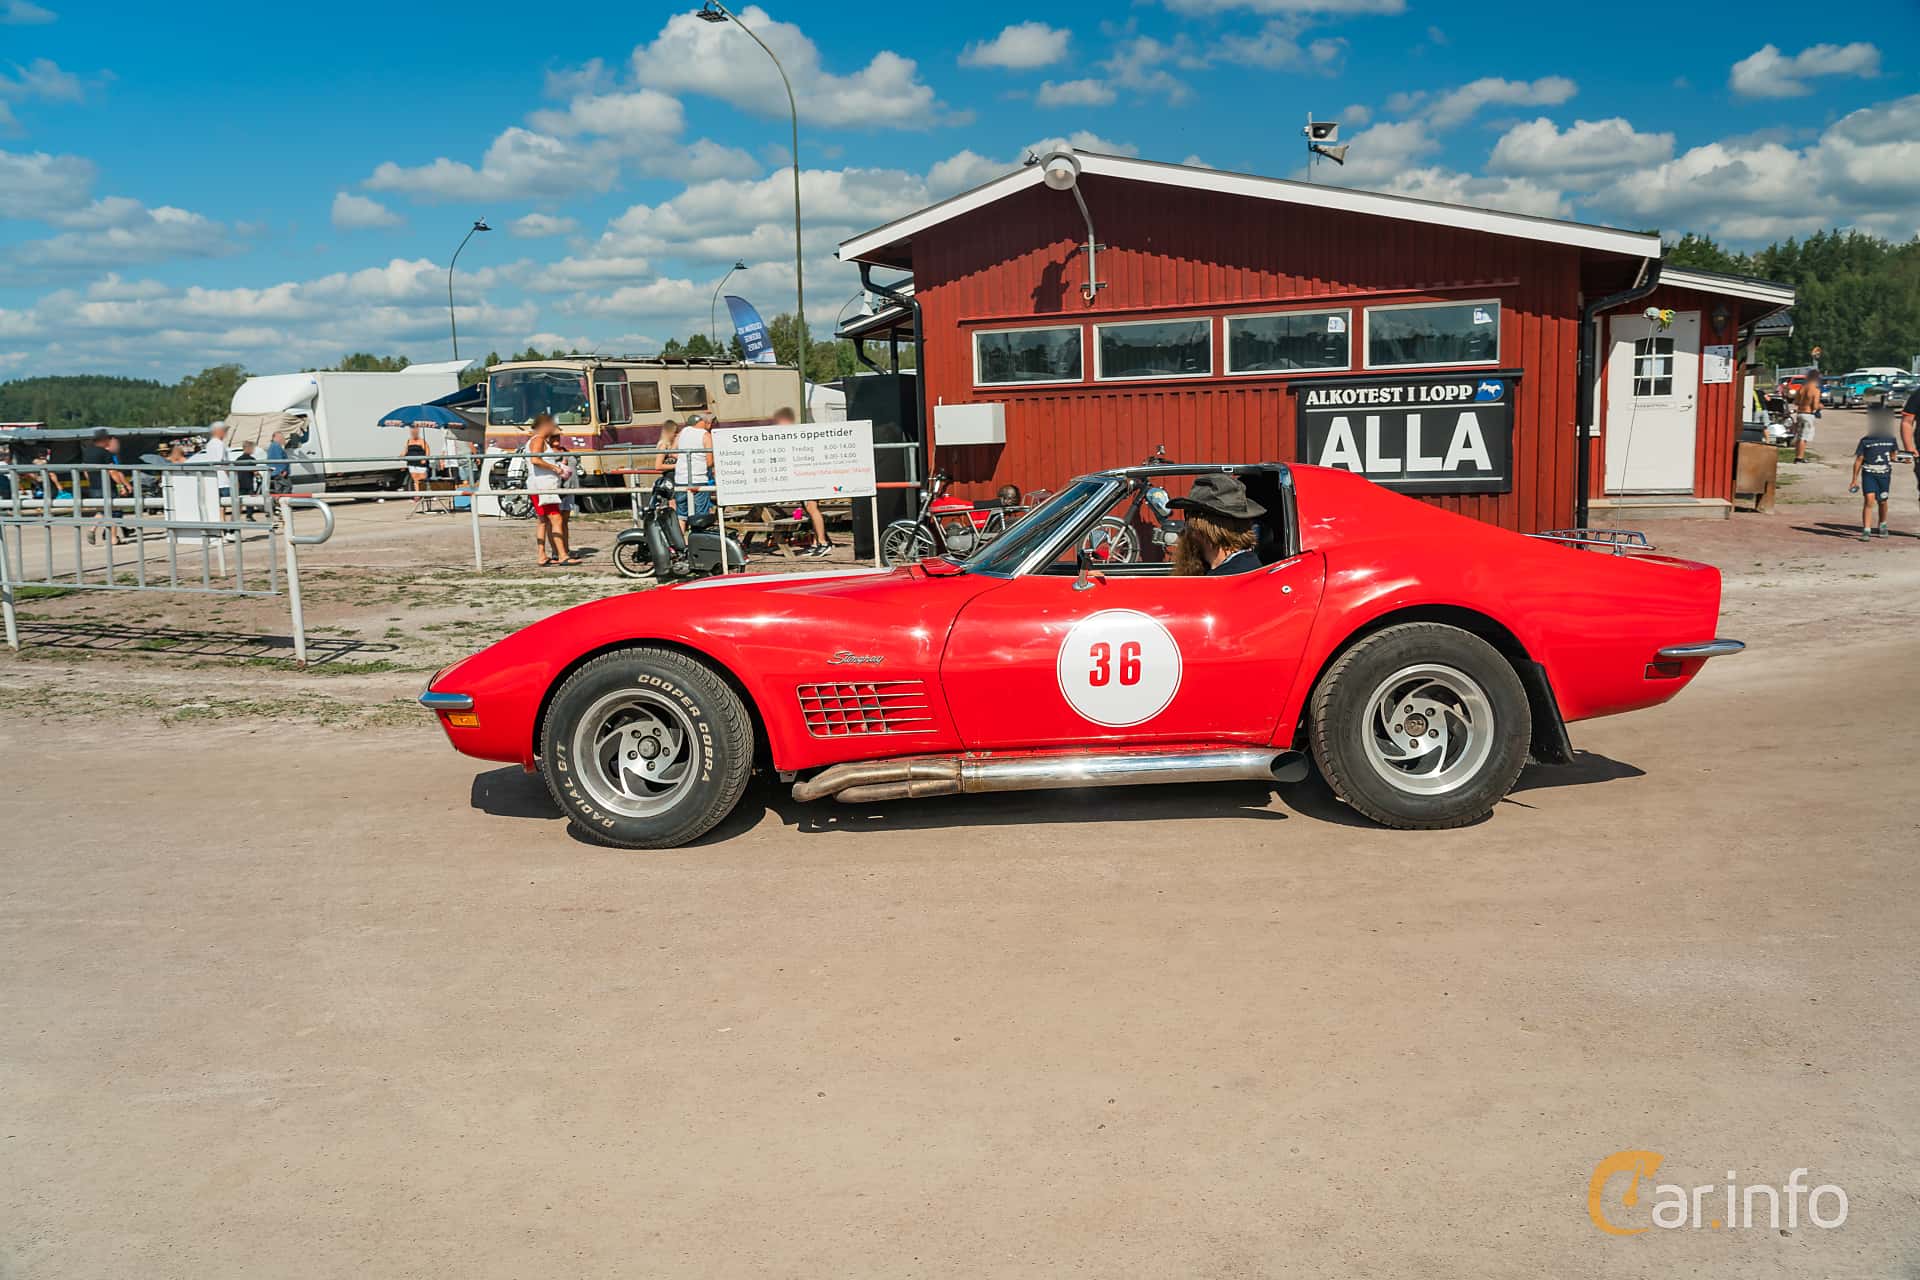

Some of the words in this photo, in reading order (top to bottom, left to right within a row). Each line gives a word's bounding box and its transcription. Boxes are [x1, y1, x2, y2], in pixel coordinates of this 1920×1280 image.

[1306, 386, 1403, 406] ALKOTEST
[1408, 387, 1415, 401] I
[1420, 384, 1473, 401] LOPP
[732, 434, 759, 443] Stora
[761, 432, 798, 441] banans
[1318, 411, 1493, 473] ALLA
[1089, 641, 1141, 687] 36
[638, 674, 701, 717] COOPER
[699, 722, 713, 783] COBRA
[564, 777, 616, 829] RADIAL
